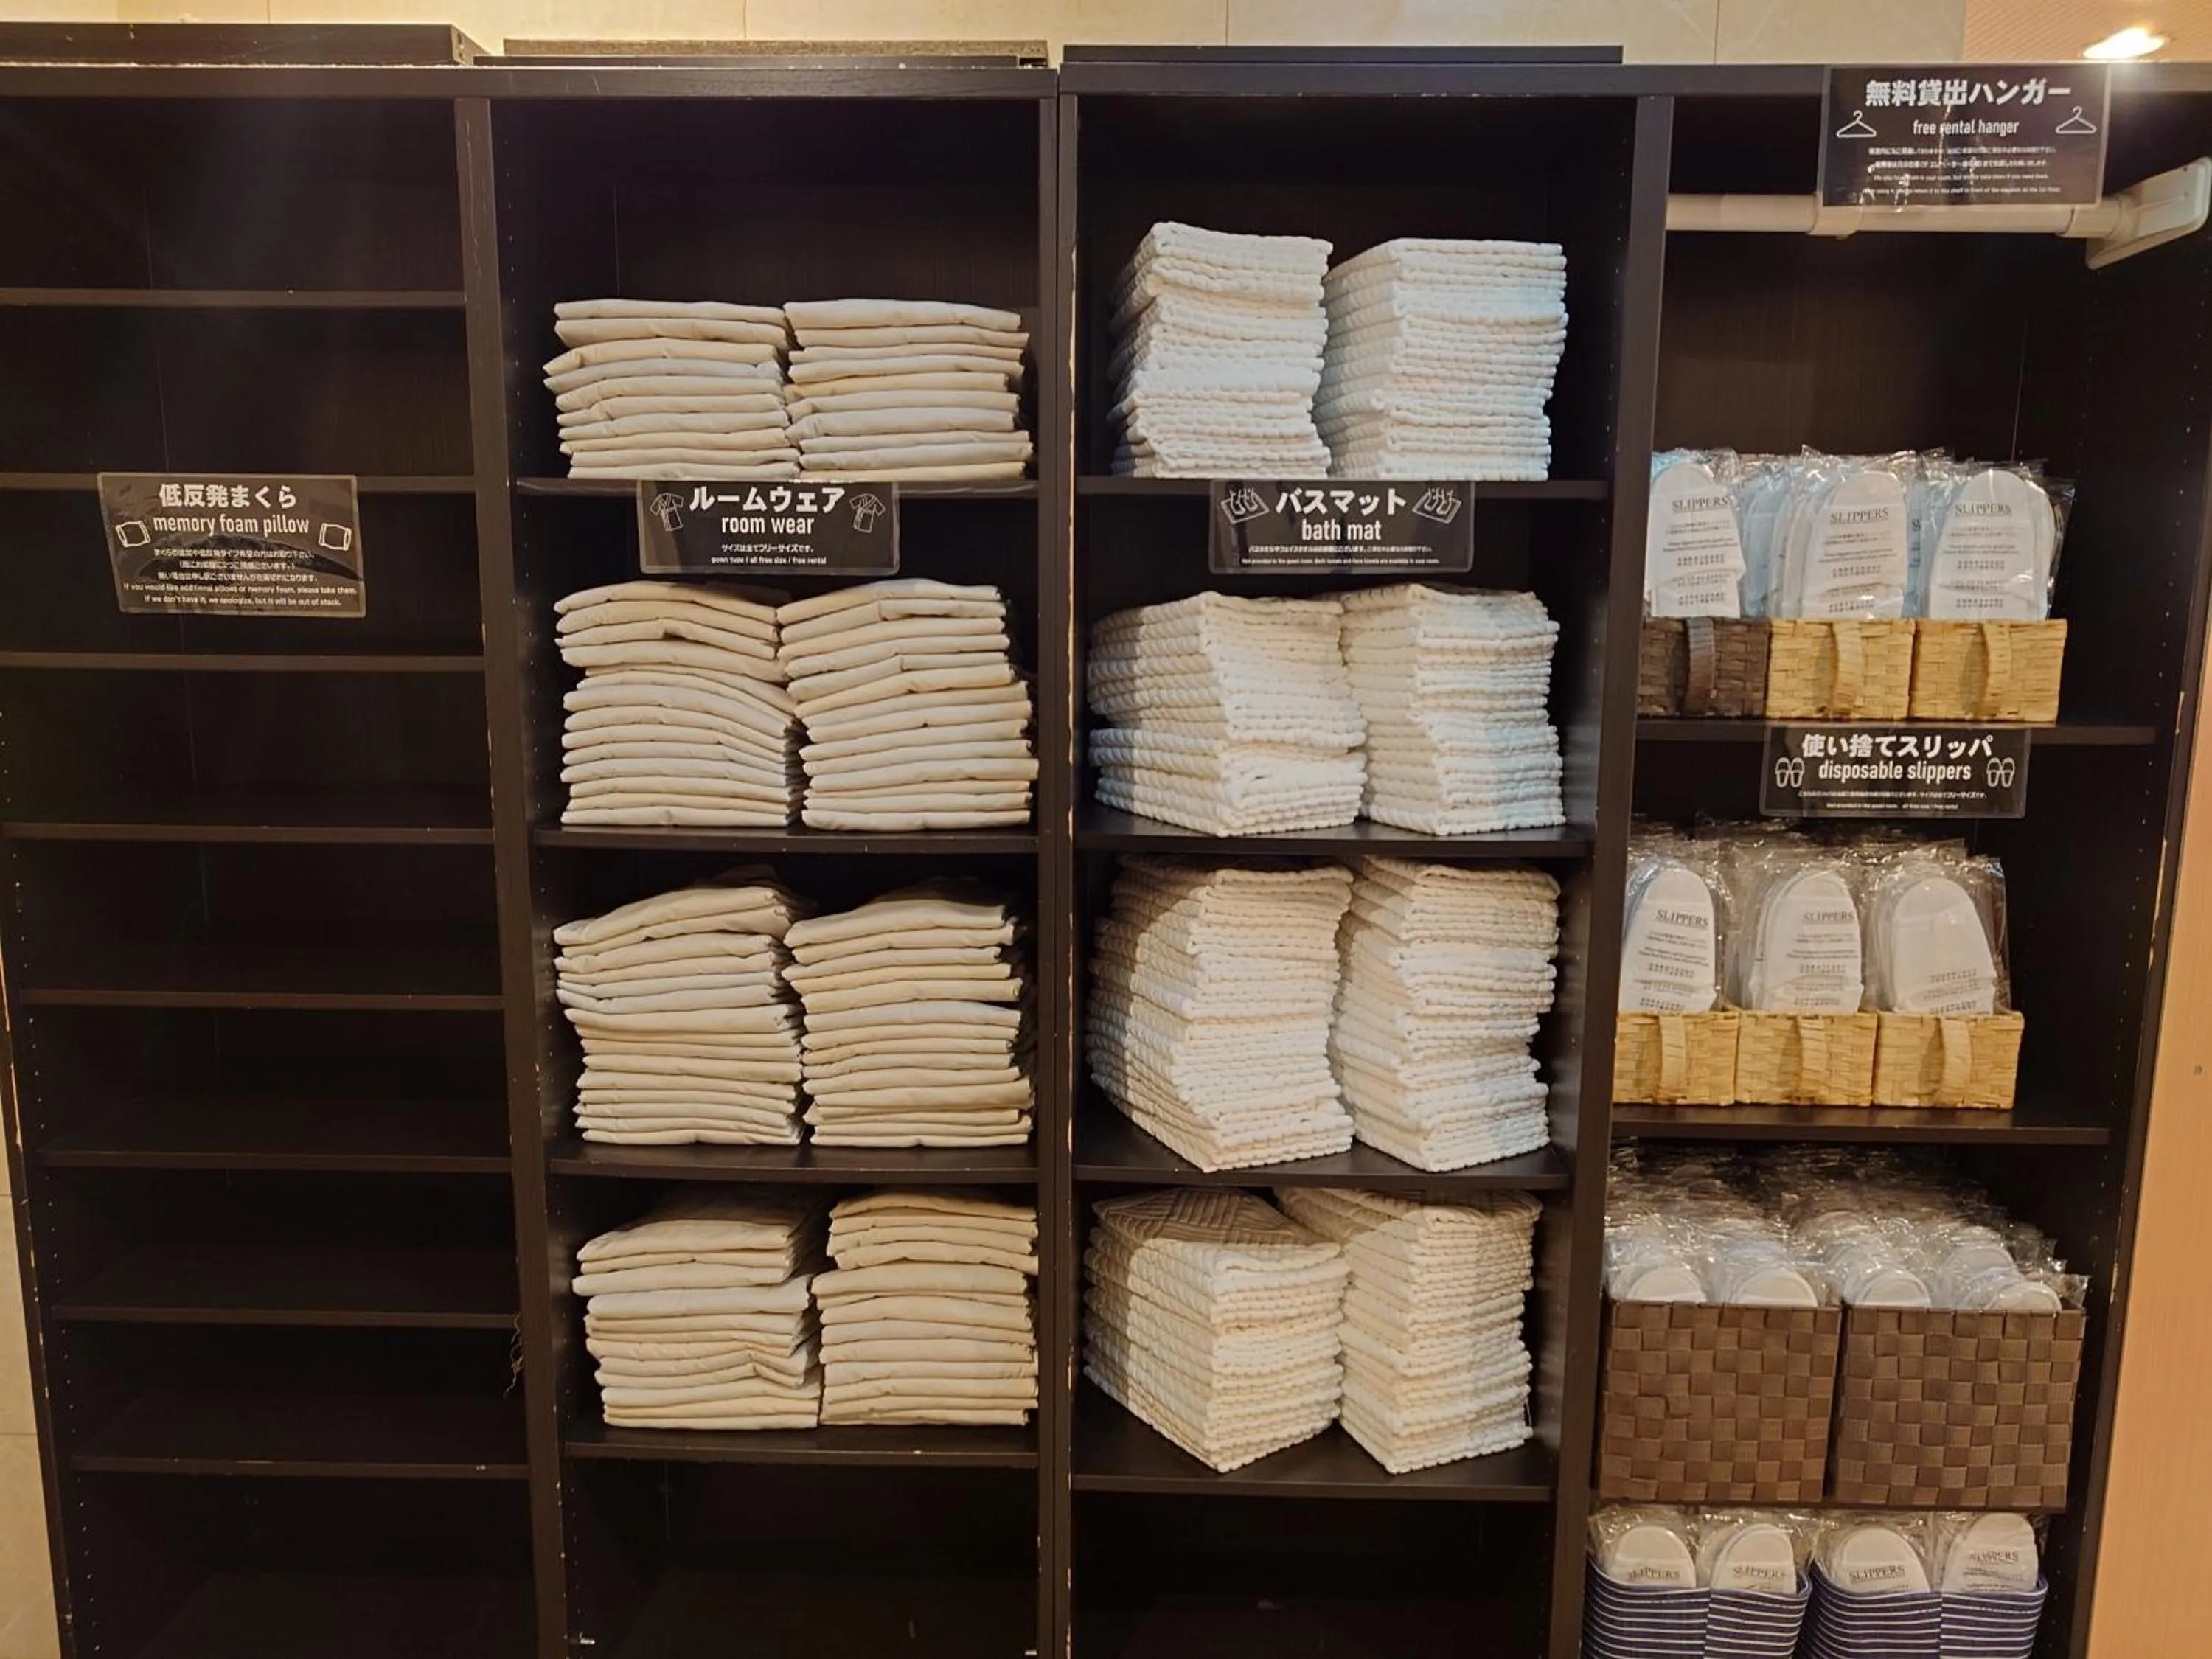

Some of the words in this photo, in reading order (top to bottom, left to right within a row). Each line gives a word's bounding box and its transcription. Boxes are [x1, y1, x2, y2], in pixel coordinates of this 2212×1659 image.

[1865, 77, 2072, 107] 無料貸出ハンガー
[1913, 120, 1936, 135] free
[1940, 119, 1976, 135] rental
[1978, 119, 2020, 137] hanger
[159, 483, 297, 509] 低反発まくら
[689, 485, 846, 514] ルームウェア
[1275, 487, 1407, 516] バスマット
[1672, 495, 1729, 511] SLIPPERS
[1830, 507, 1889, 522] SLIPPERS
[1955, 504, 2012, 515] SLIPPERS
[153, 515, 215, 535] memory
[219, 514, 258, 533] foam
[262, 515, 310, 537] pillow
[721, 517, 766, 535] room
[771, 518, 815, 535] wear
[1301, 518, 1341, 540] bath
[1347, 520, 1382, 540] mat
[1801, 733, 1994, 759] 使い捨てスリッパ
[1818, 760, 1902, 784] disposable
[1907, 760, 1972, 784] slippers
[1657, 908, 1709, 927] SLIPPERS
